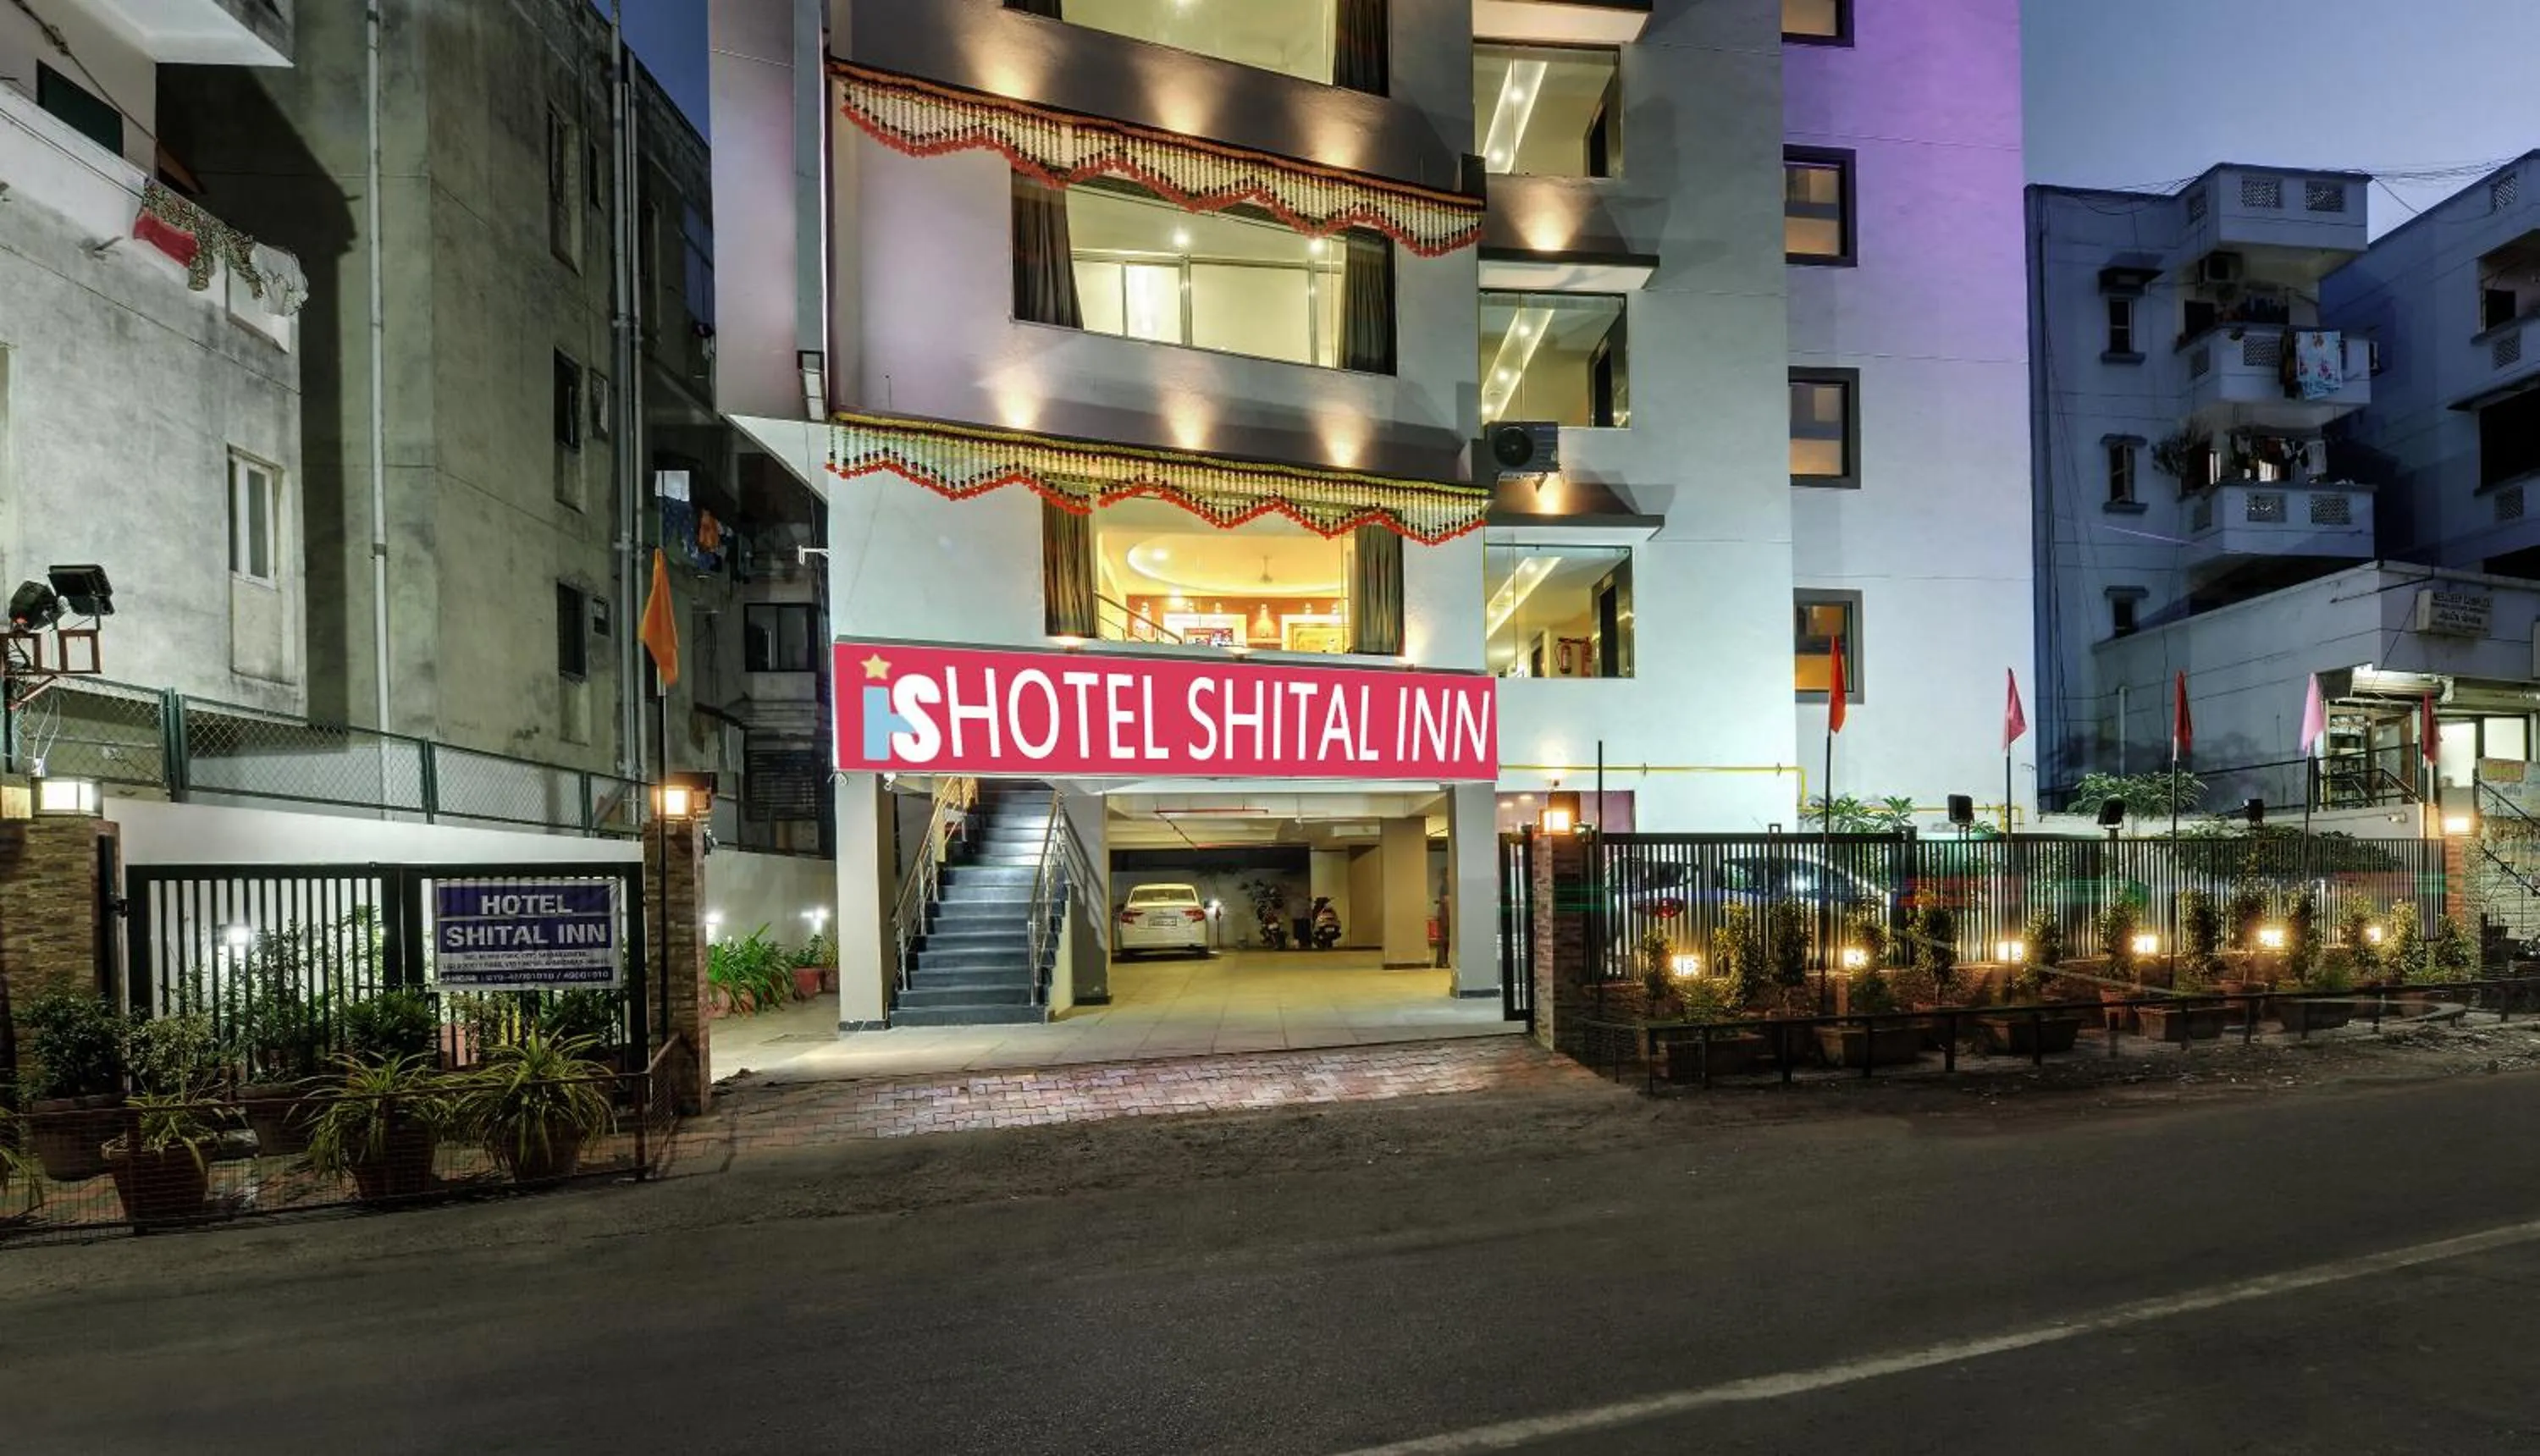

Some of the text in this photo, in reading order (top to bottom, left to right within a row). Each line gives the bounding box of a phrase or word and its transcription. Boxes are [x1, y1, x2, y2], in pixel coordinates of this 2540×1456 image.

[946, 666, 1169, 759] HOTEL
[1188, 676, 1378, 760] SHITAL
[1396, 687, 1490, 763] INN
[481, 895, 573, 915] HOTEL
[446, 923, 606, 946] SHITAL INN
